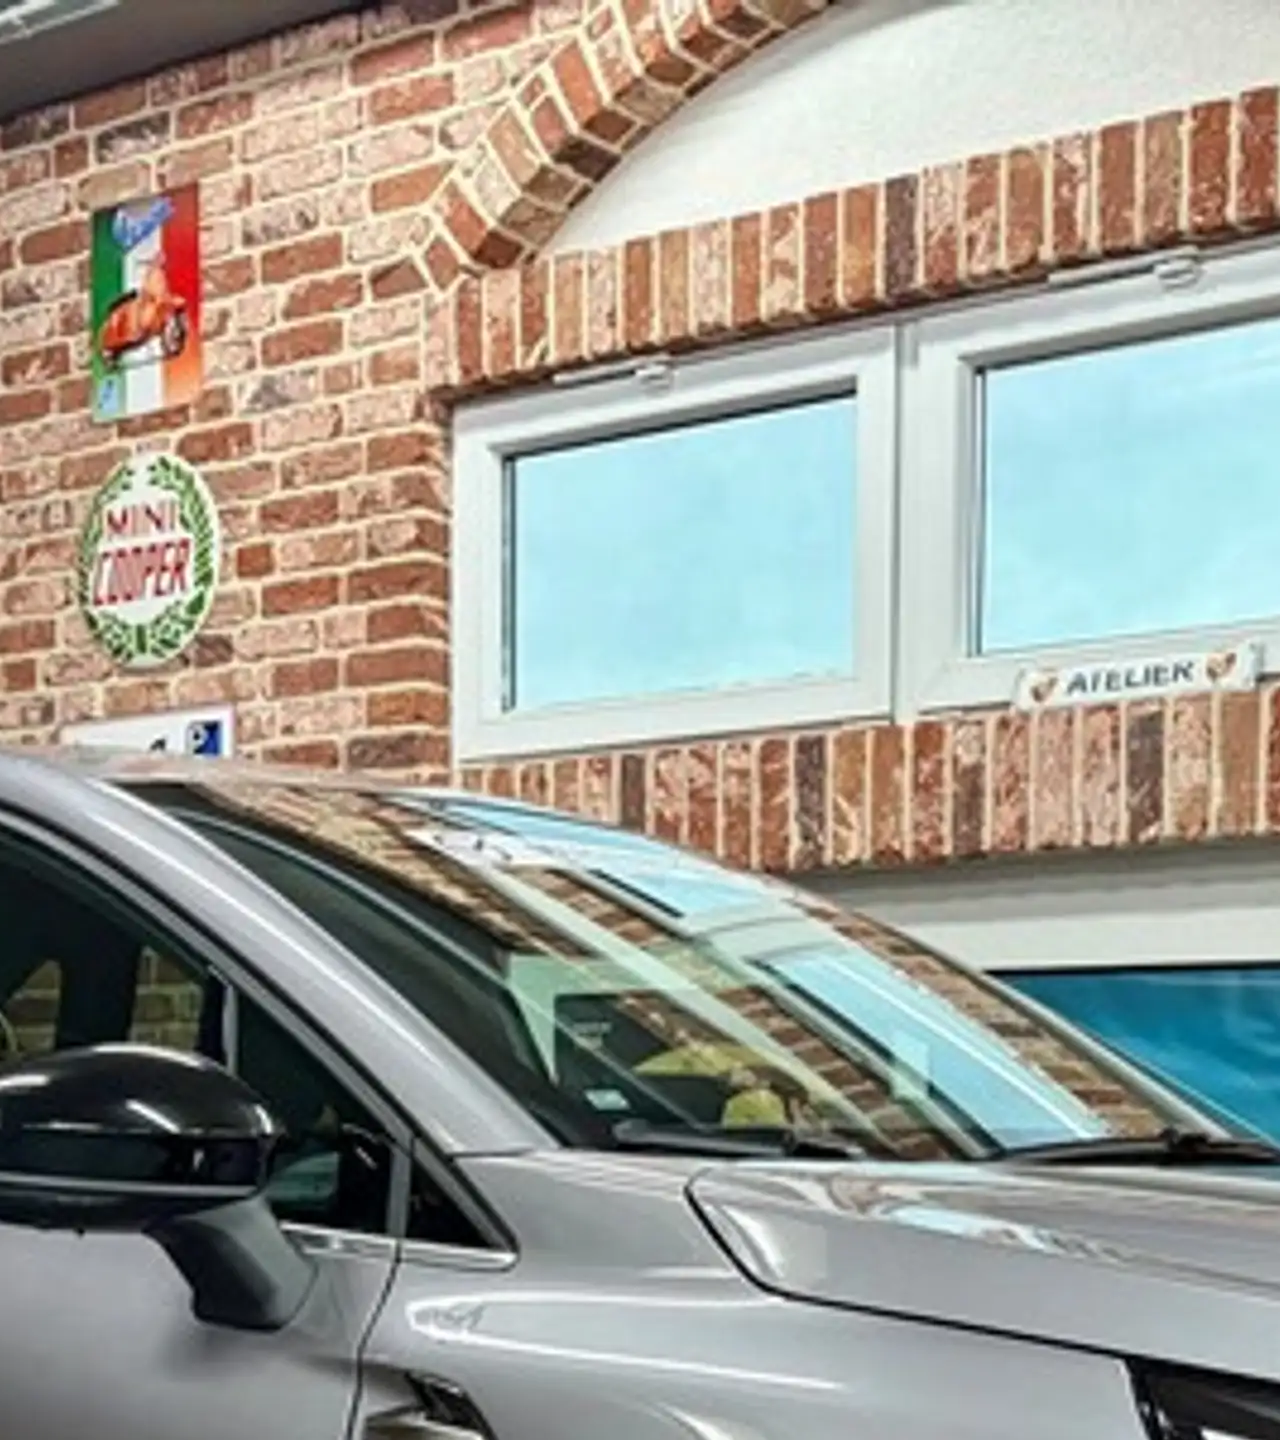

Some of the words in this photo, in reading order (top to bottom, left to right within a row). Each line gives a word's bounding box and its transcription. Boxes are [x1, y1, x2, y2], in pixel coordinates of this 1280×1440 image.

[105, 498, 177, 540] MINI
[93, 538, 190, 606] COOPER
[1067, 661, 1193, 694] ATELIER
